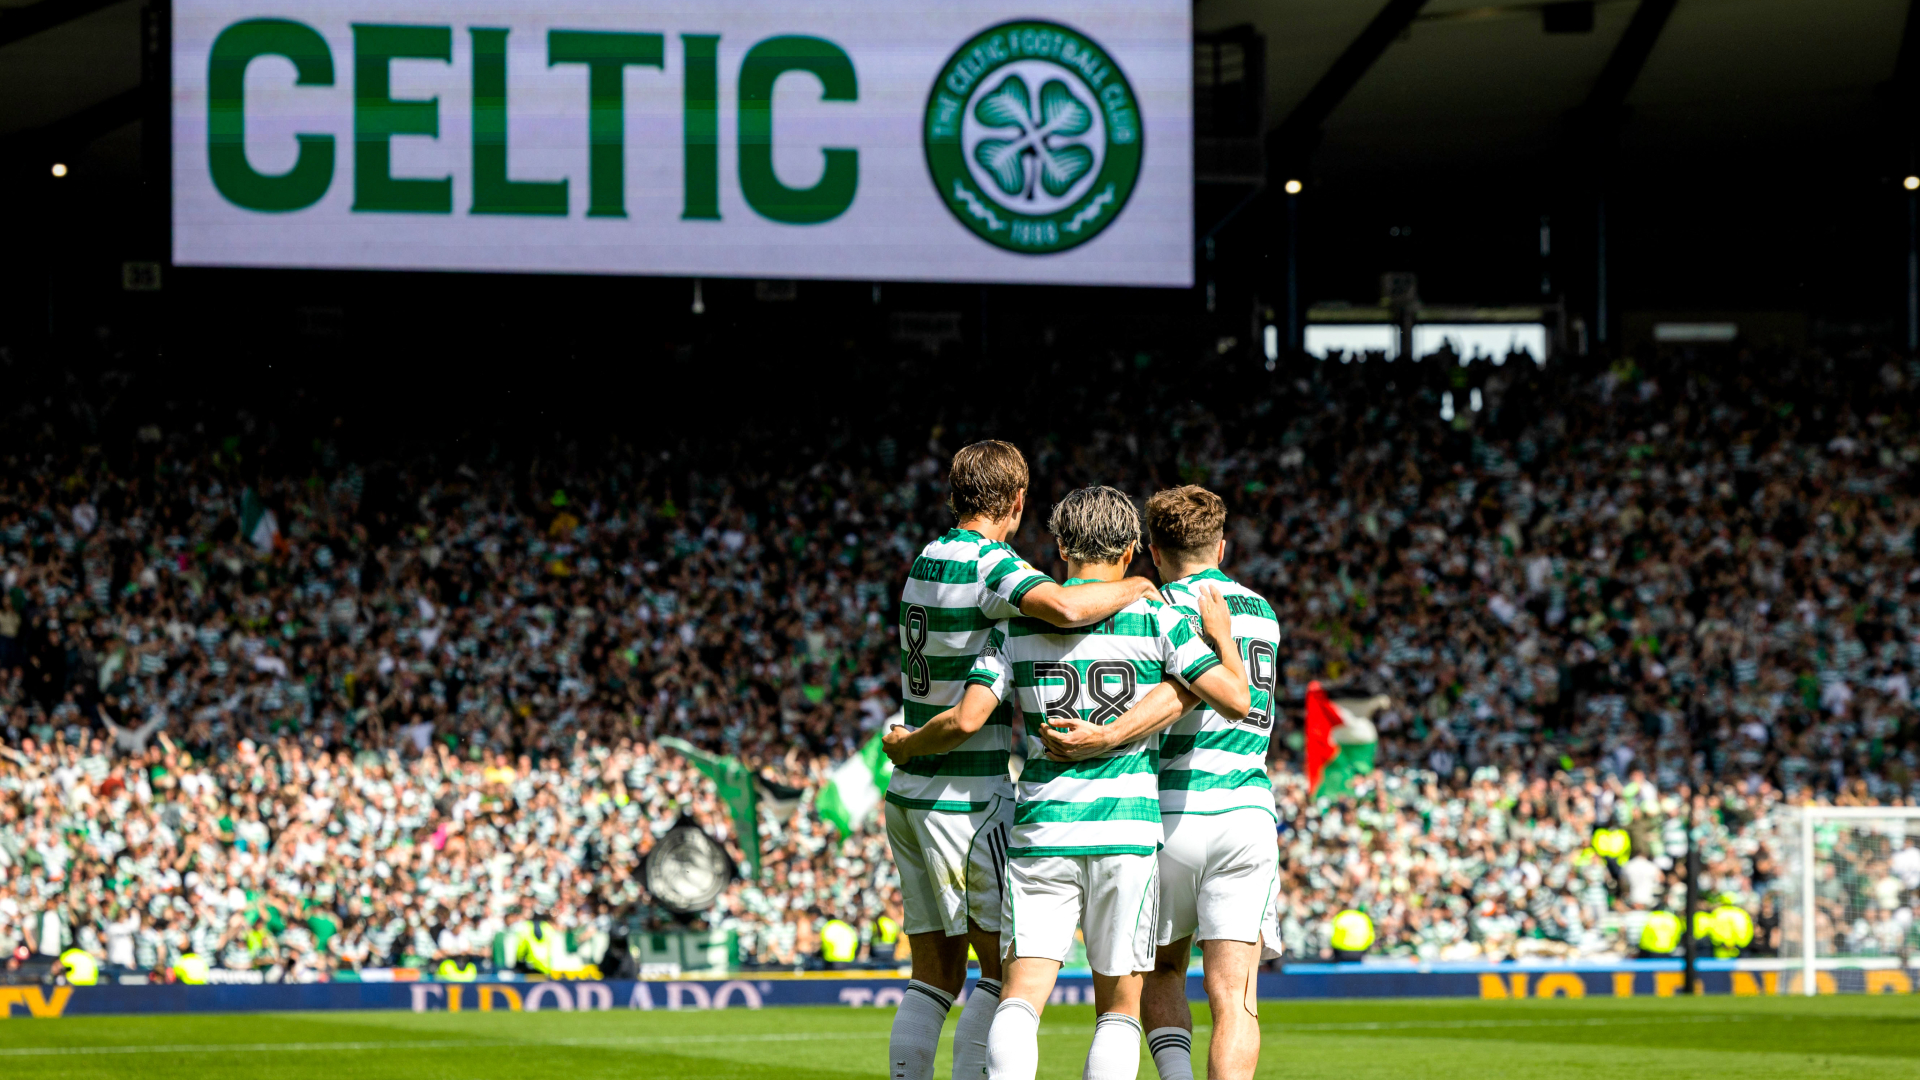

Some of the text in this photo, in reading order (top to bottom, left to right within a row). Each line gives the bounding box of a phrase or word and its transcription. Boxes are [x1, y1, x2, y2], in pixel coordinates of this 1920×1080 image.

[1007, 27, 1109, 91] FOOTBALL
[206, 16, 860, 226] CELTIC
[905, 603, 931, 699] 8
[1032, 659, 1137, 755] 38
